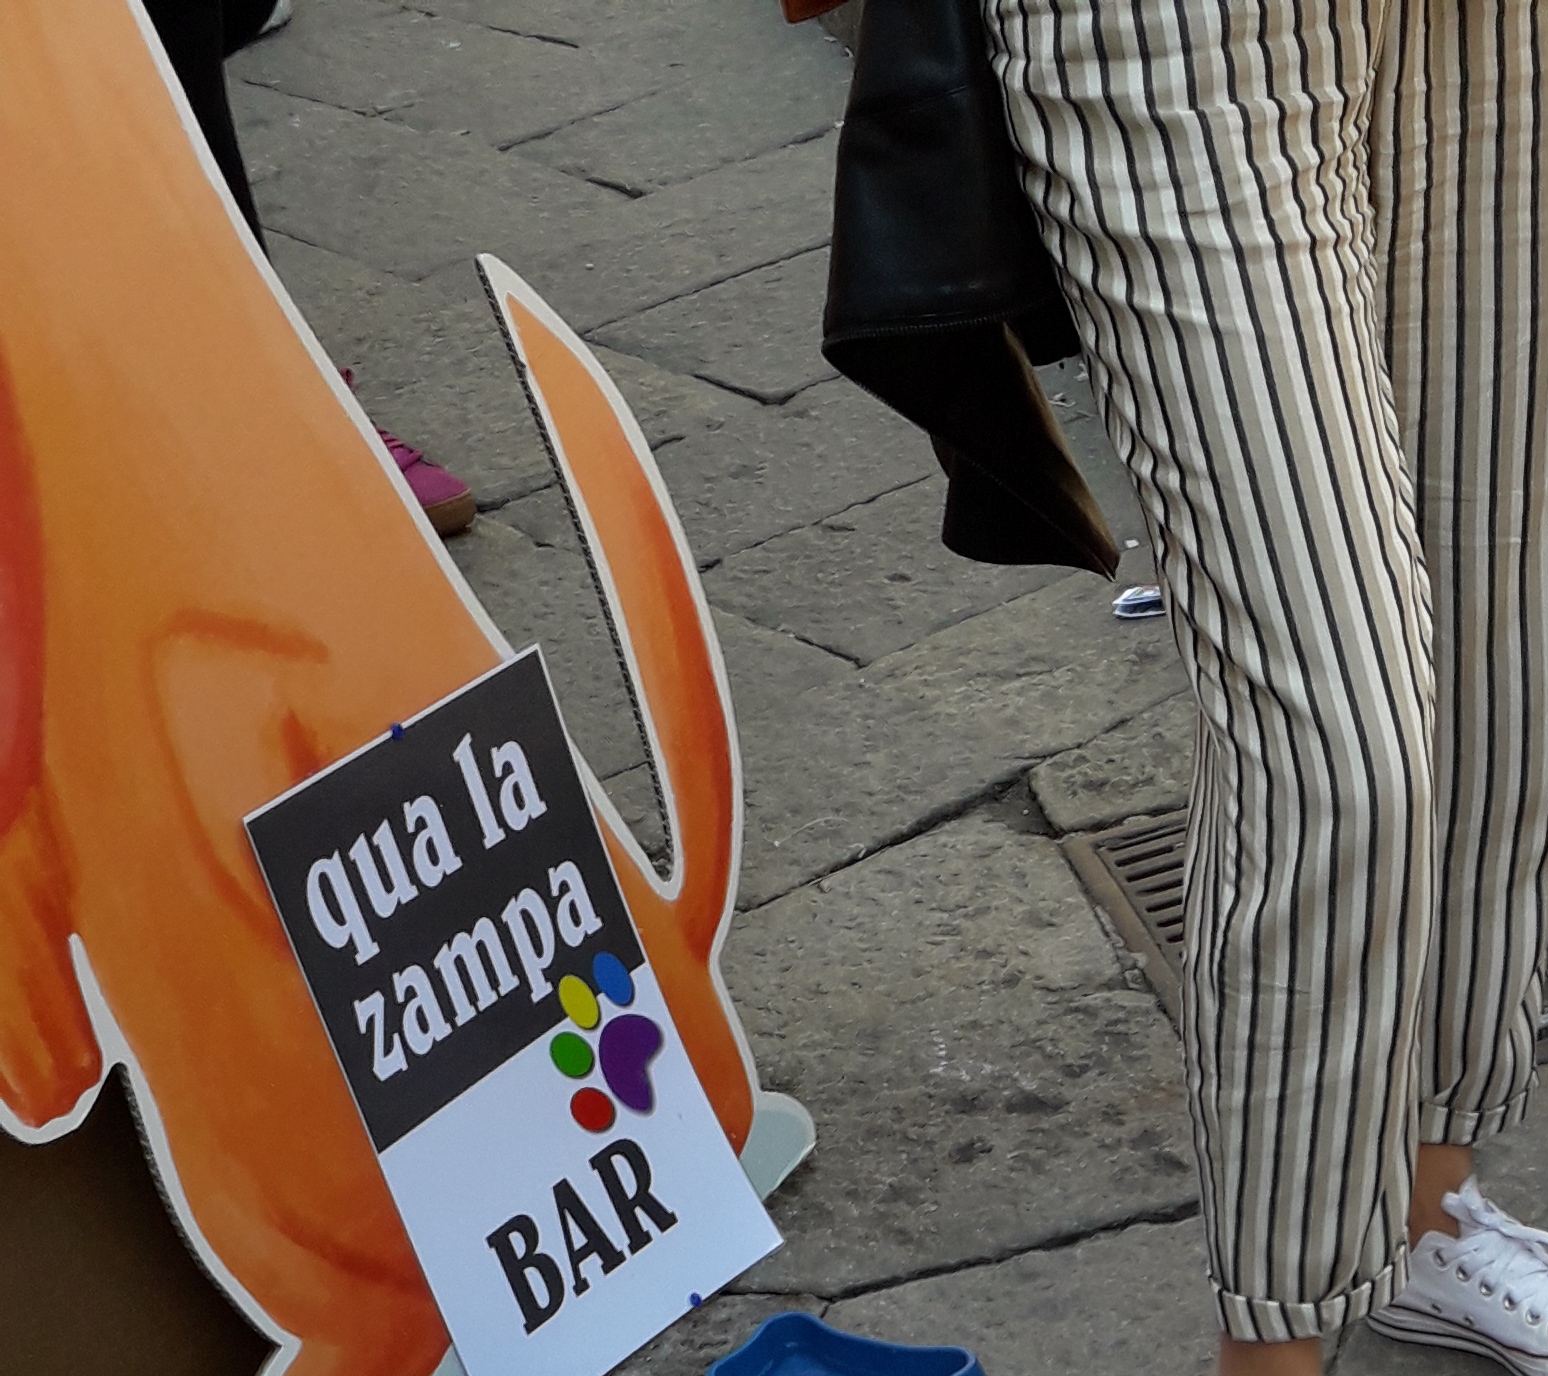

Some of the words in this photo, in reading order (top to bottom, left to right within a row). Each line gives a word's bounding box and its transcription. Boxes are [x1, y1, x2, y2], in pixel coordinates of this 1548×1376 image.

[306, 793, 463, 966] qua
[452, 732, 548, 848] la
[354, 858, 603, 1083] zampa
[485, 1137, 679, 1337] BAR
